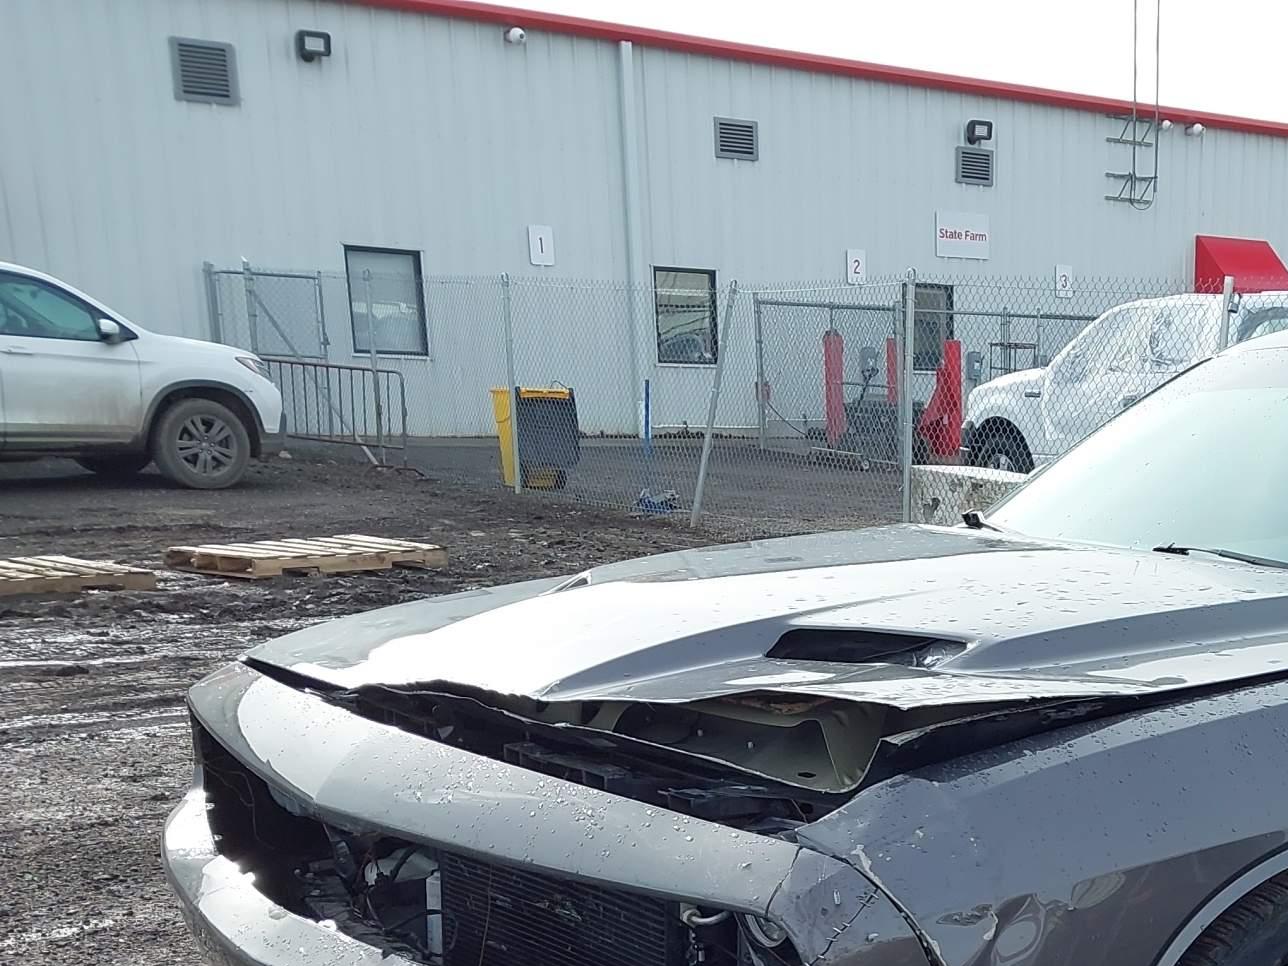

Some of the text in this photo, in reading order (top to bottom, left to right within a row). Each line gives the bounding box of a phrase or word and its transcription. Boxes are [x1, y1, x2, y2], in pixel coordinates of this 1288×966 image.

[939, 228, 987, 241] State Farm
[538, 236, 544, 254] 1
[853, 259, 861, 275] 2
[1061, 274, 1068, 289] 3
